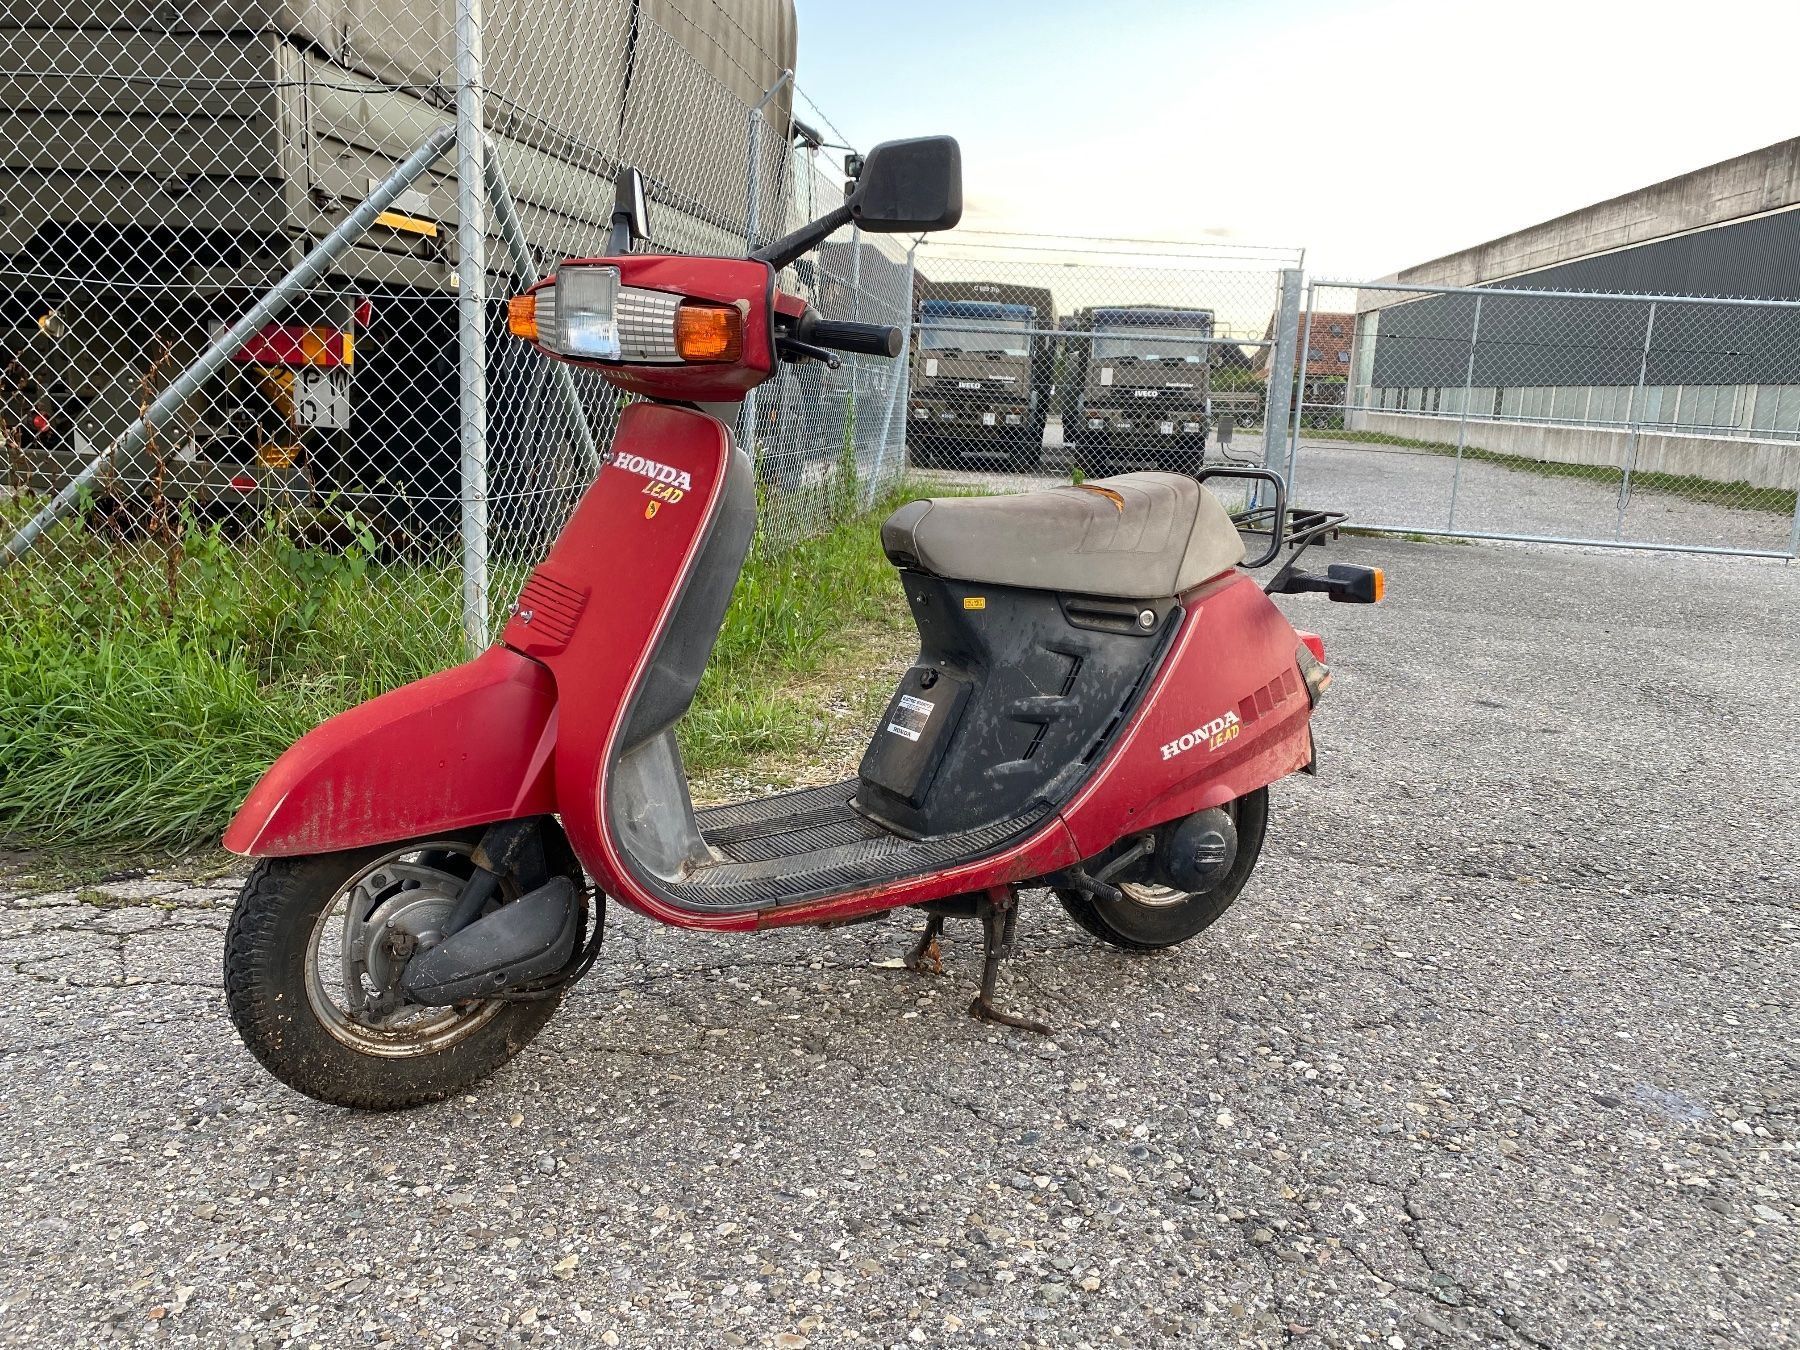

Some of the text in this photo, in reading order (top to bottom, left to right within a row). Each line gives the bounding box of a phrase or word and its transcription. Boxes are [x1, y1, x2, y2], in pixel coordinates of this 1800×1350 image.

[329, 370, 348, 397] W
[613, 452, 692, 491] HONDA
[642, 481, 684, 504] LEAD
[1160, 711, 1240, 761] HONDA
[1209, 725, 1240, 752] LEAD
